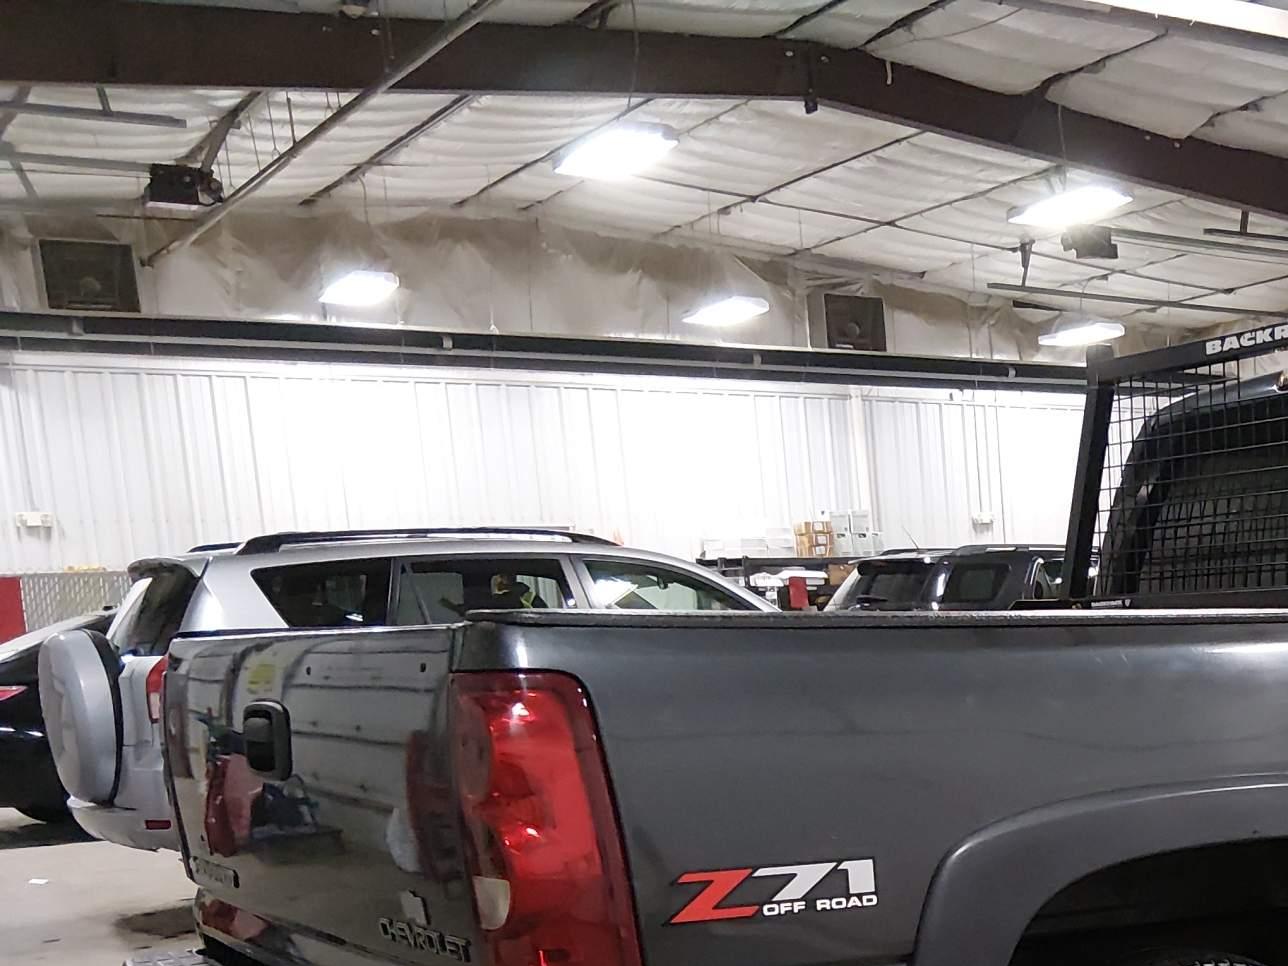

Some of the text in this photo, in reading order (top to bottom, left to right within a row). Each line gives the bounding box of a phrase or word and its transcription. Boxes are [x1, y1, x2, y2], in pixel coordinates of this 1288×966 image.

[670, 858, 876, 924] Z71
[762, 894, 878, 917] OFF ROAD
